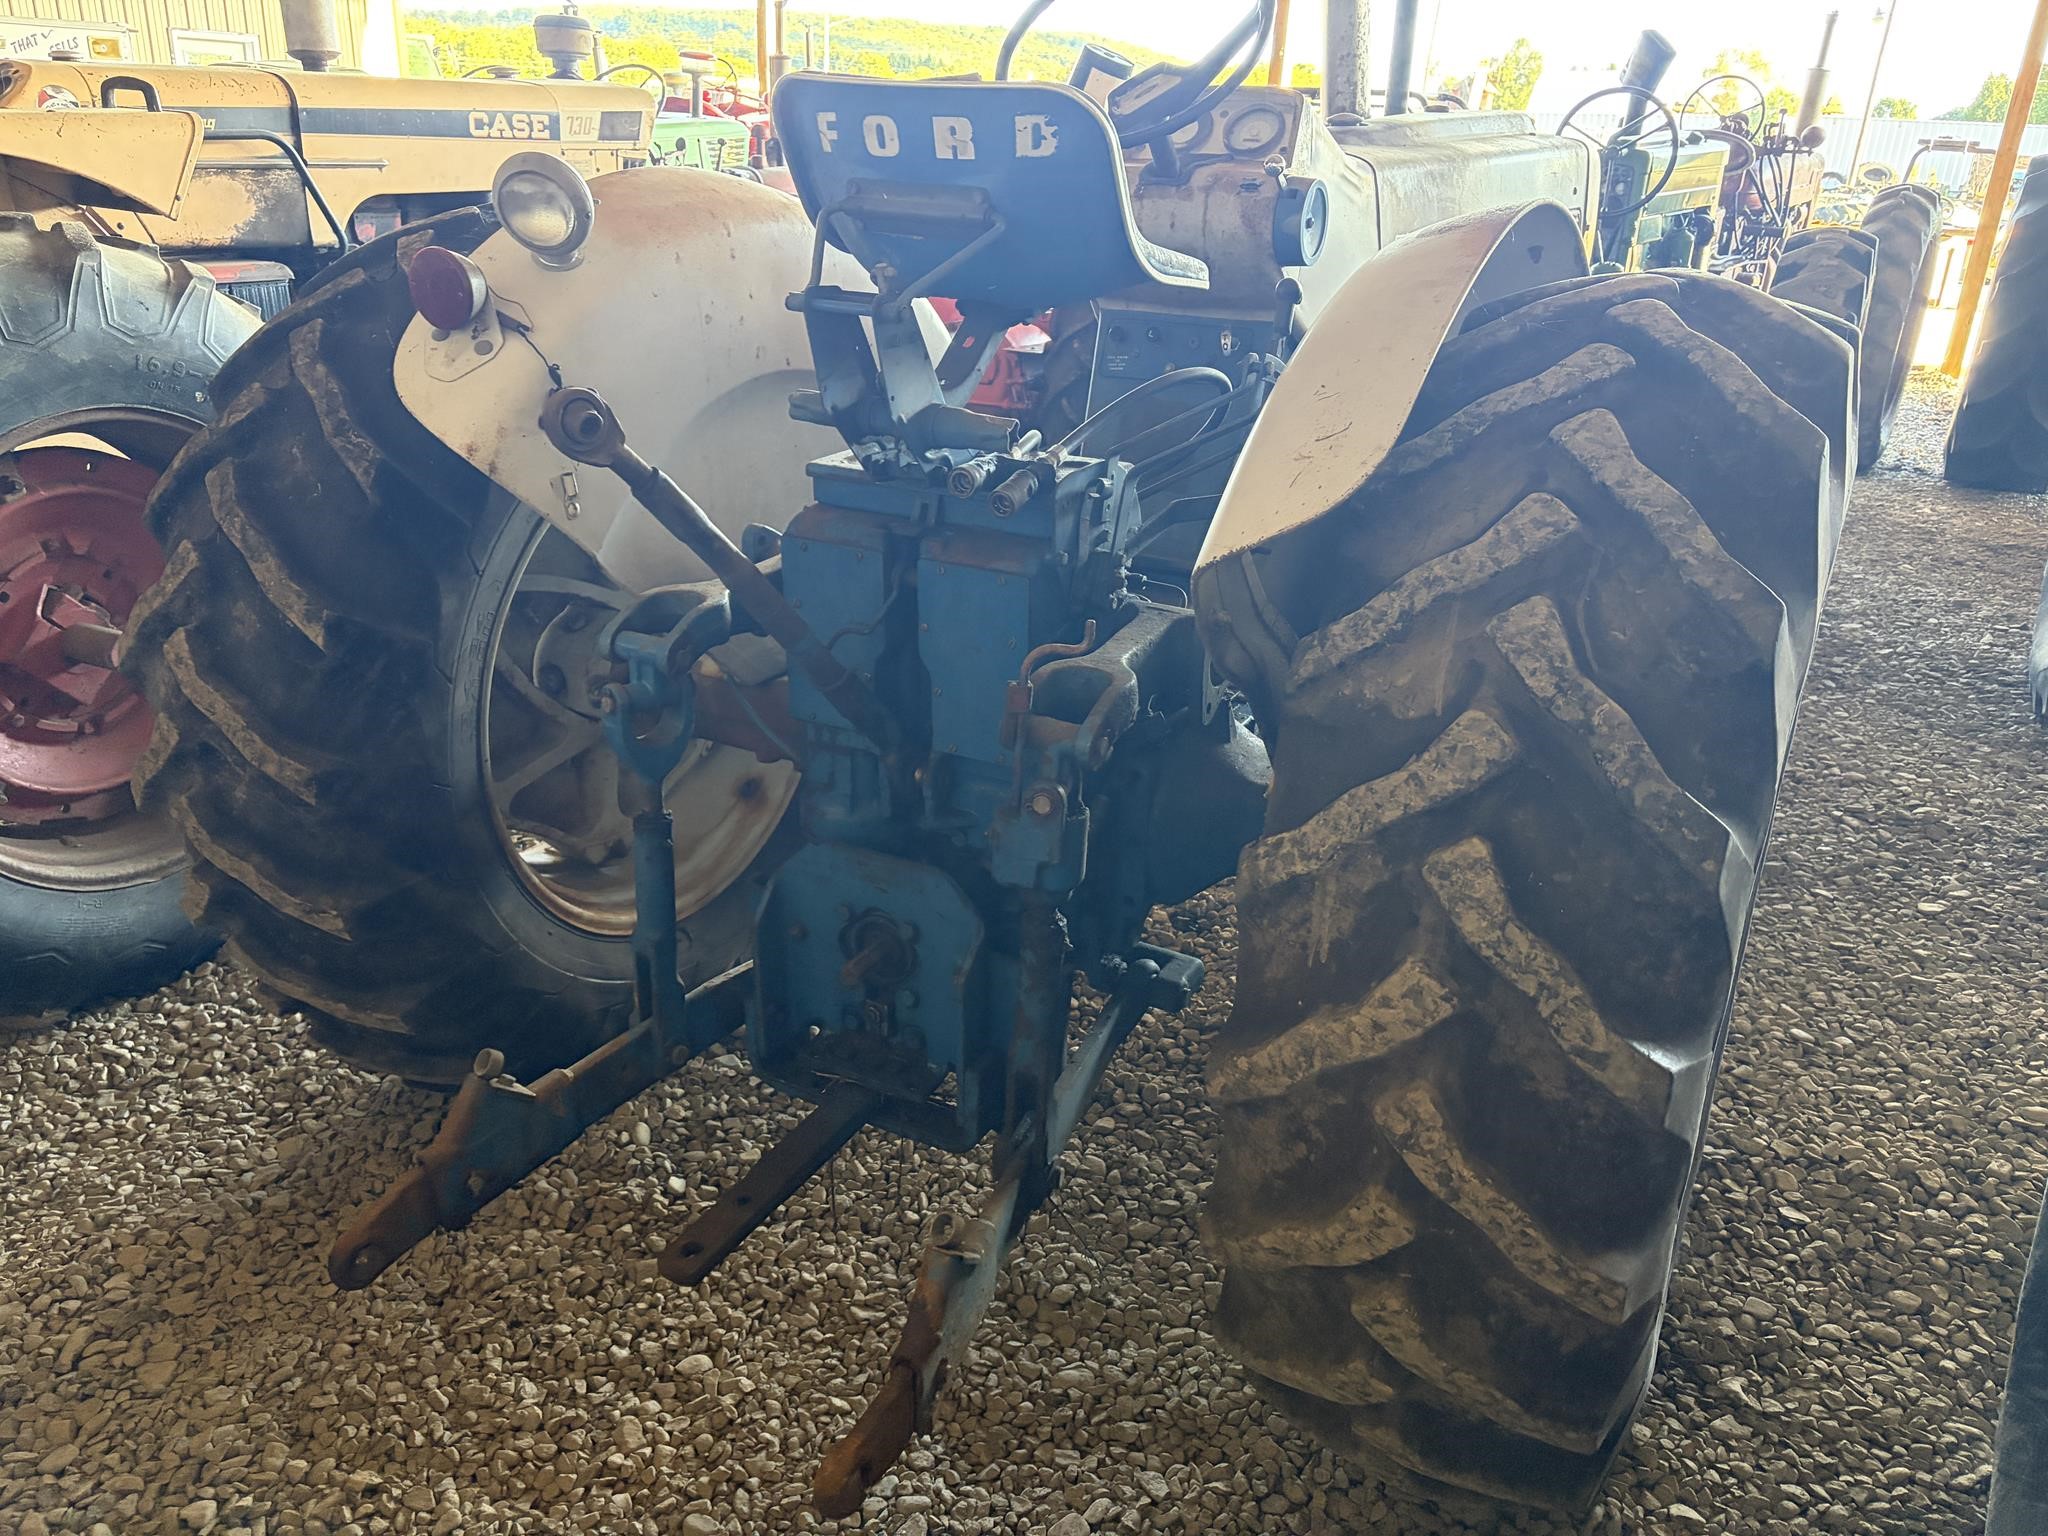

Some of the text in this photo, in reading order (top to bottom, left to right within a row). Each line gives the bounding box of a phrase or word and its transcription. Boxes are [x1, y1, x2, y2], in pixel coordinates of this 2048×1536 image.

[10, 34, 38, 54] THAT
[469, 112, 550, 139] CASE
[566, 116, 593, 136] 730
[816, 111, 1058, 160] FORD
